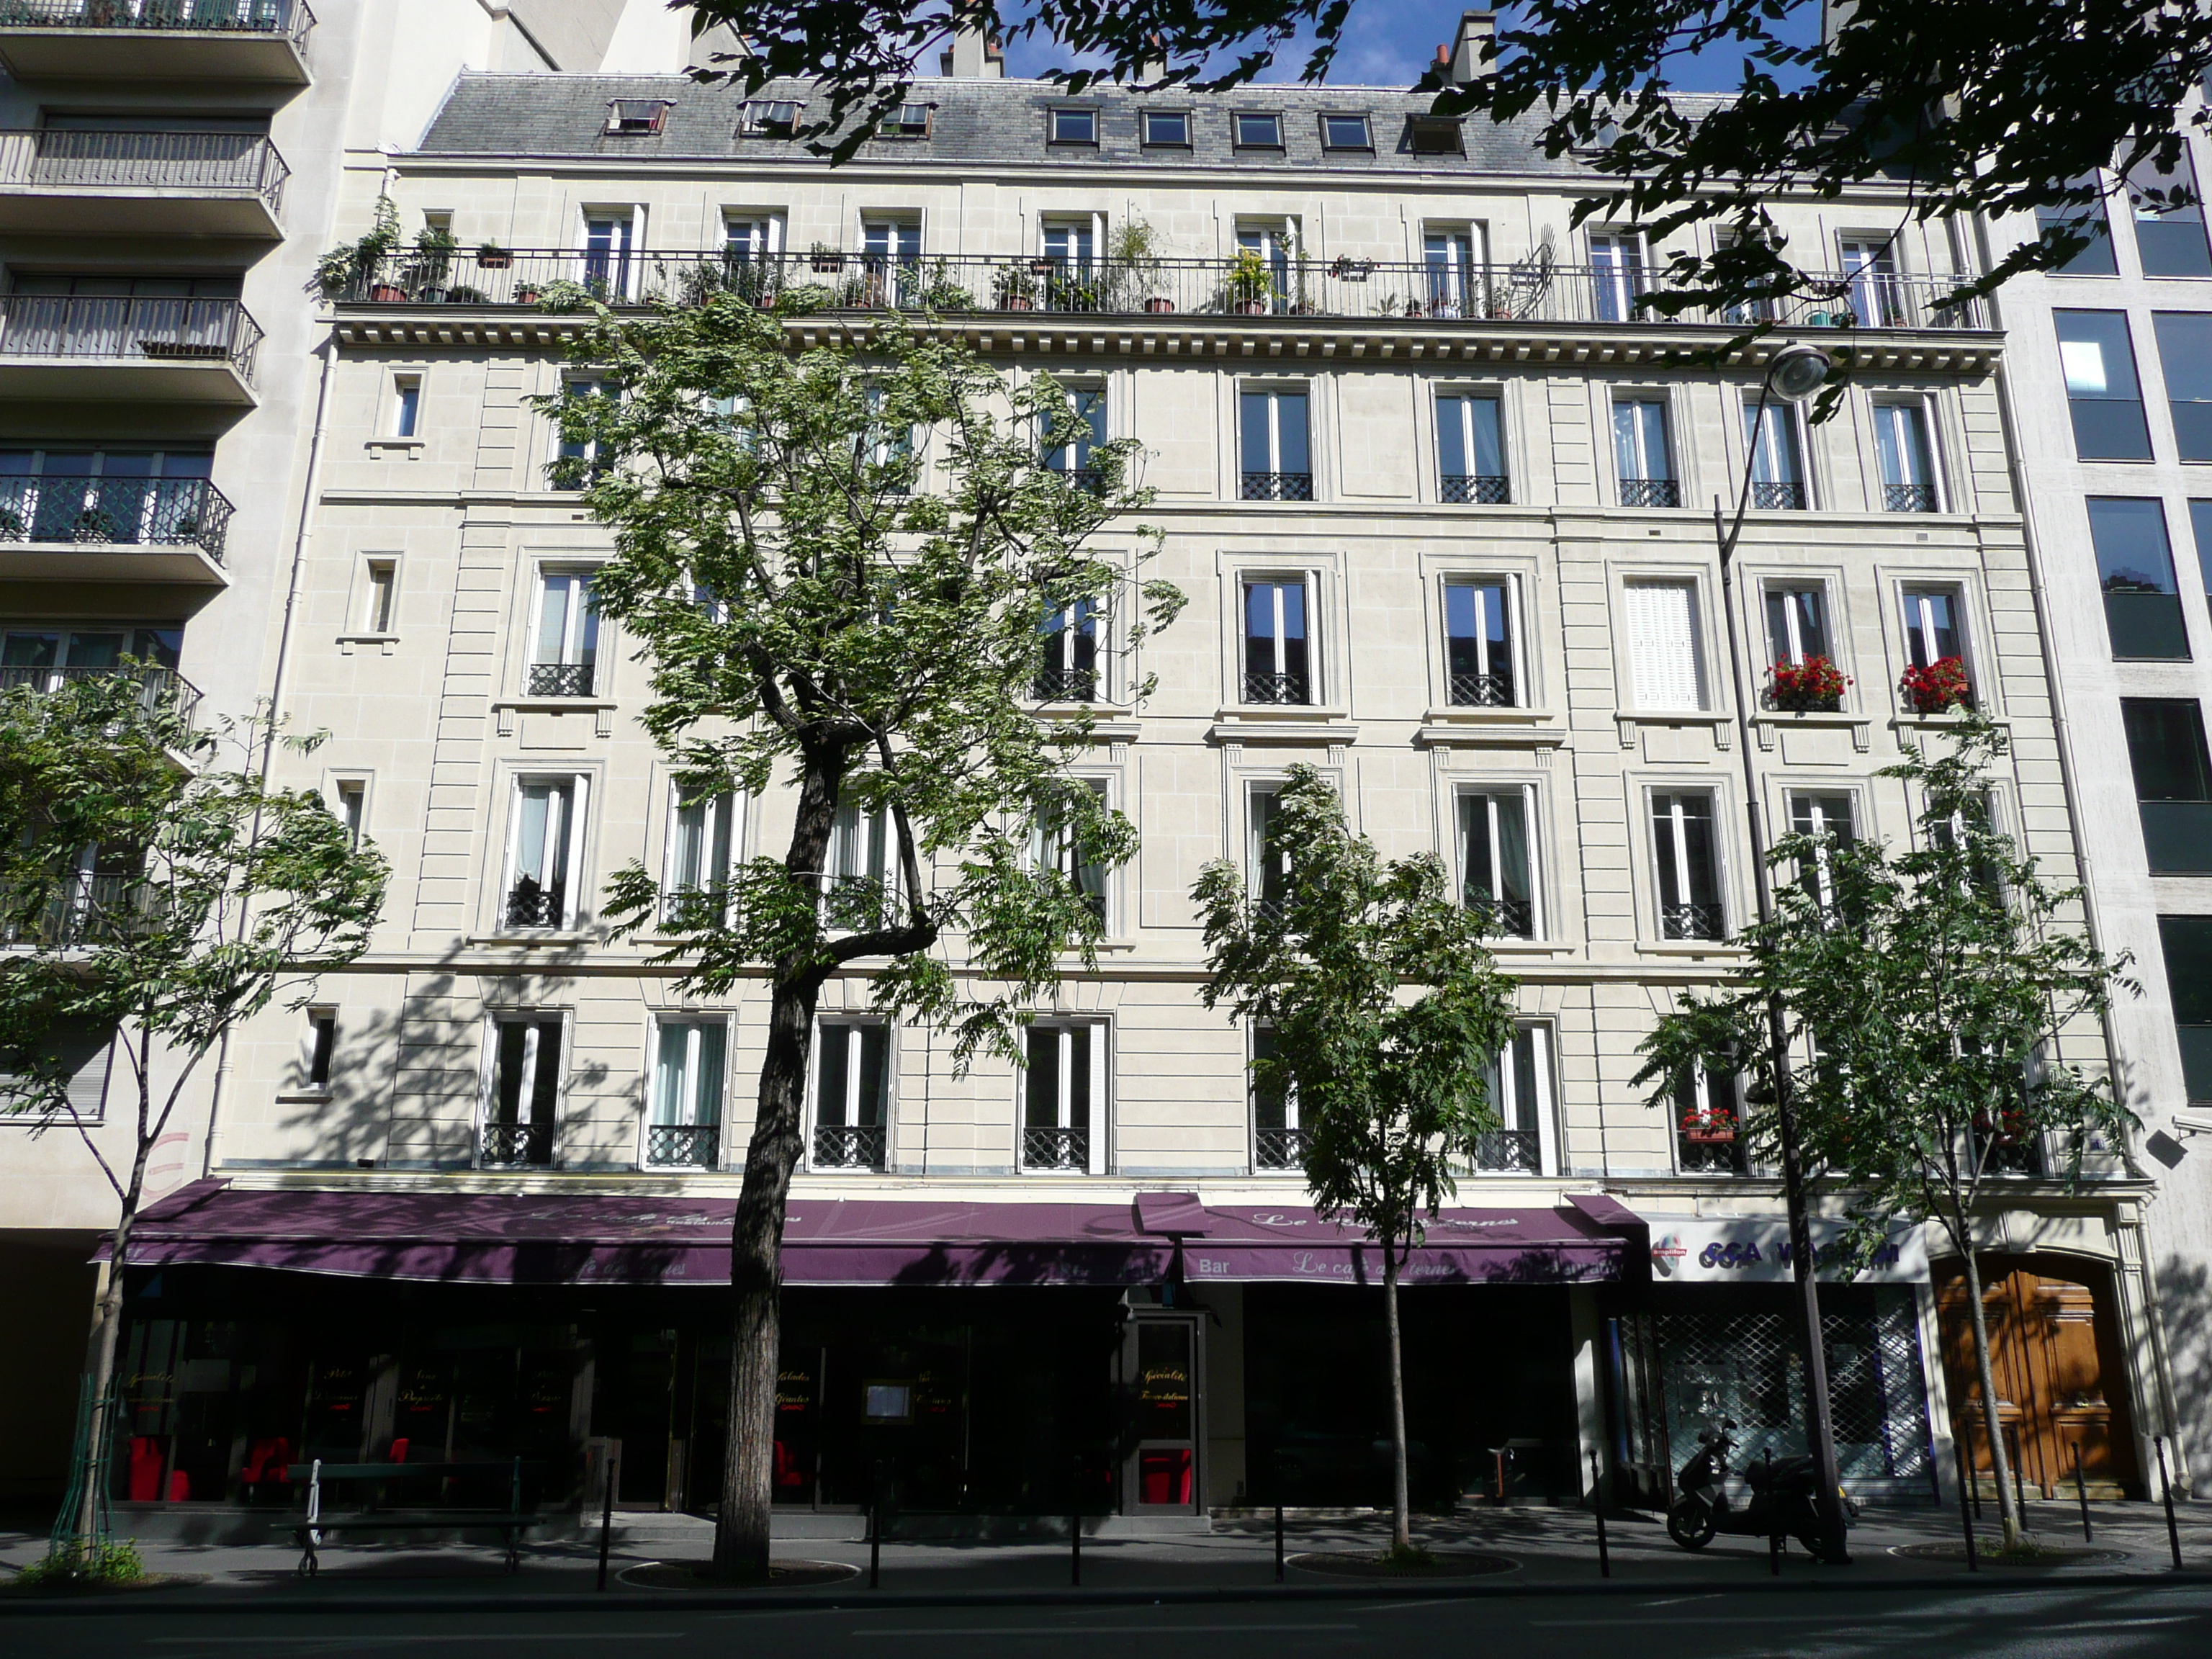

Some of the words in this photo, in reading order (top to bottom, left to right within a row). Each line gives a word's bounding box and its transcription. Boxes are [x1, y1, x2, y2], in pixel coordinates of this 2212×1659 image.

[1251, 1213, 1307, 1226] Le
[1707, 1243, 1762, 1261] CCA
[1199, 1259, 1229, 1274] Bar
[1292, 1251, 1326, 1273] Le
[1408, 1262, 1455, 1275] ternes
[777, 1371, 810, 1382] Salades
[775, 1393, 809, 1406] Géantes
